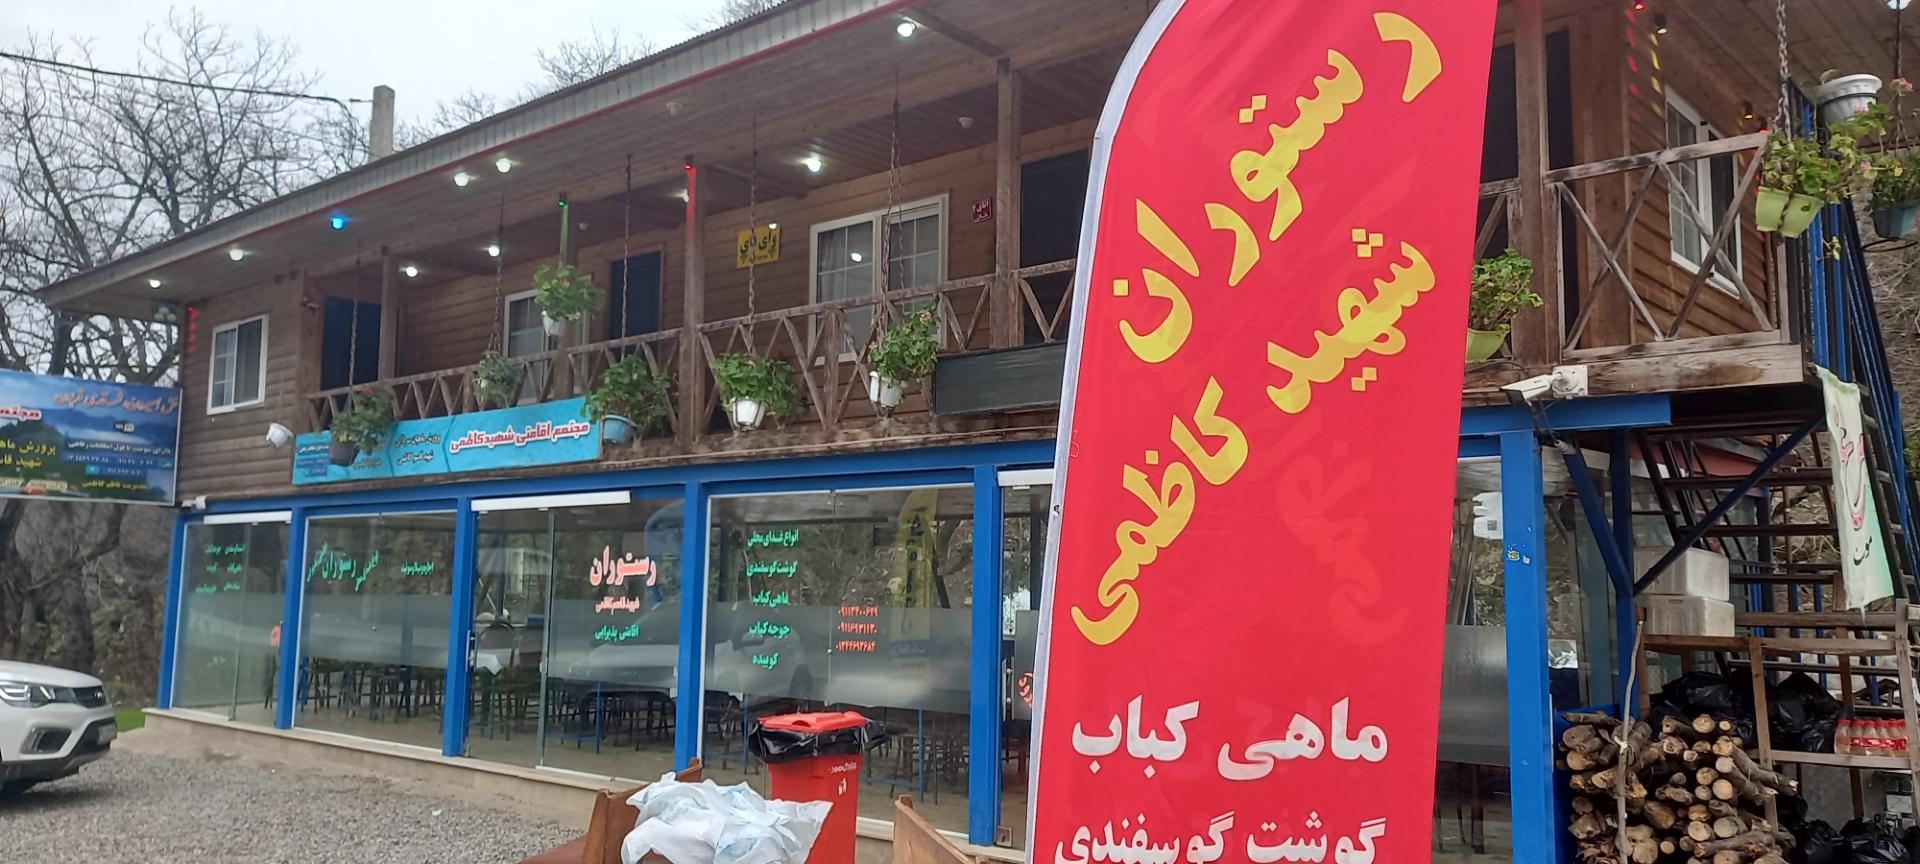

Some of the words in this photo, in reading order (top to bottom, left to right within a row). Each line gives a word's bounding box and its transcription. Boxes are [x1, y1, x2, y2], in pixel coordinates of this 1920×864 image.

[1112, 12, 1442, 363] رستوران
[1266, 227, 1436, 414] شهید
[0, 438, 16, 449] ماه
[450, 430, 484, 453] کاظمی
[484, 425, 515, 447] شهید
[515, 421, 552, 446] اقامتی
[1070, 375, 1249, 646] کاظمی
[783, 528, 799, 547] انواع
[590, 545, 657, 587] رستوران
[746, 560, 777, 578] گوسفندی
[776, 560, 799, 578] گوشت
[752, 590, 771, 607] کباب
[769, 591, 789, 608] ماهی
[749, 620, 769, 638] کباب
[768, 622, 791, 639] جوجه
[752, 651, 780, 670] کوبیده
[1071, 694, 1200, 779] کباب
[1217, 696, 1388, 781] ماهی
[1054, 809, 1236, 864] گوسفندی
[1245, 809, 1388, 864] گوشت
